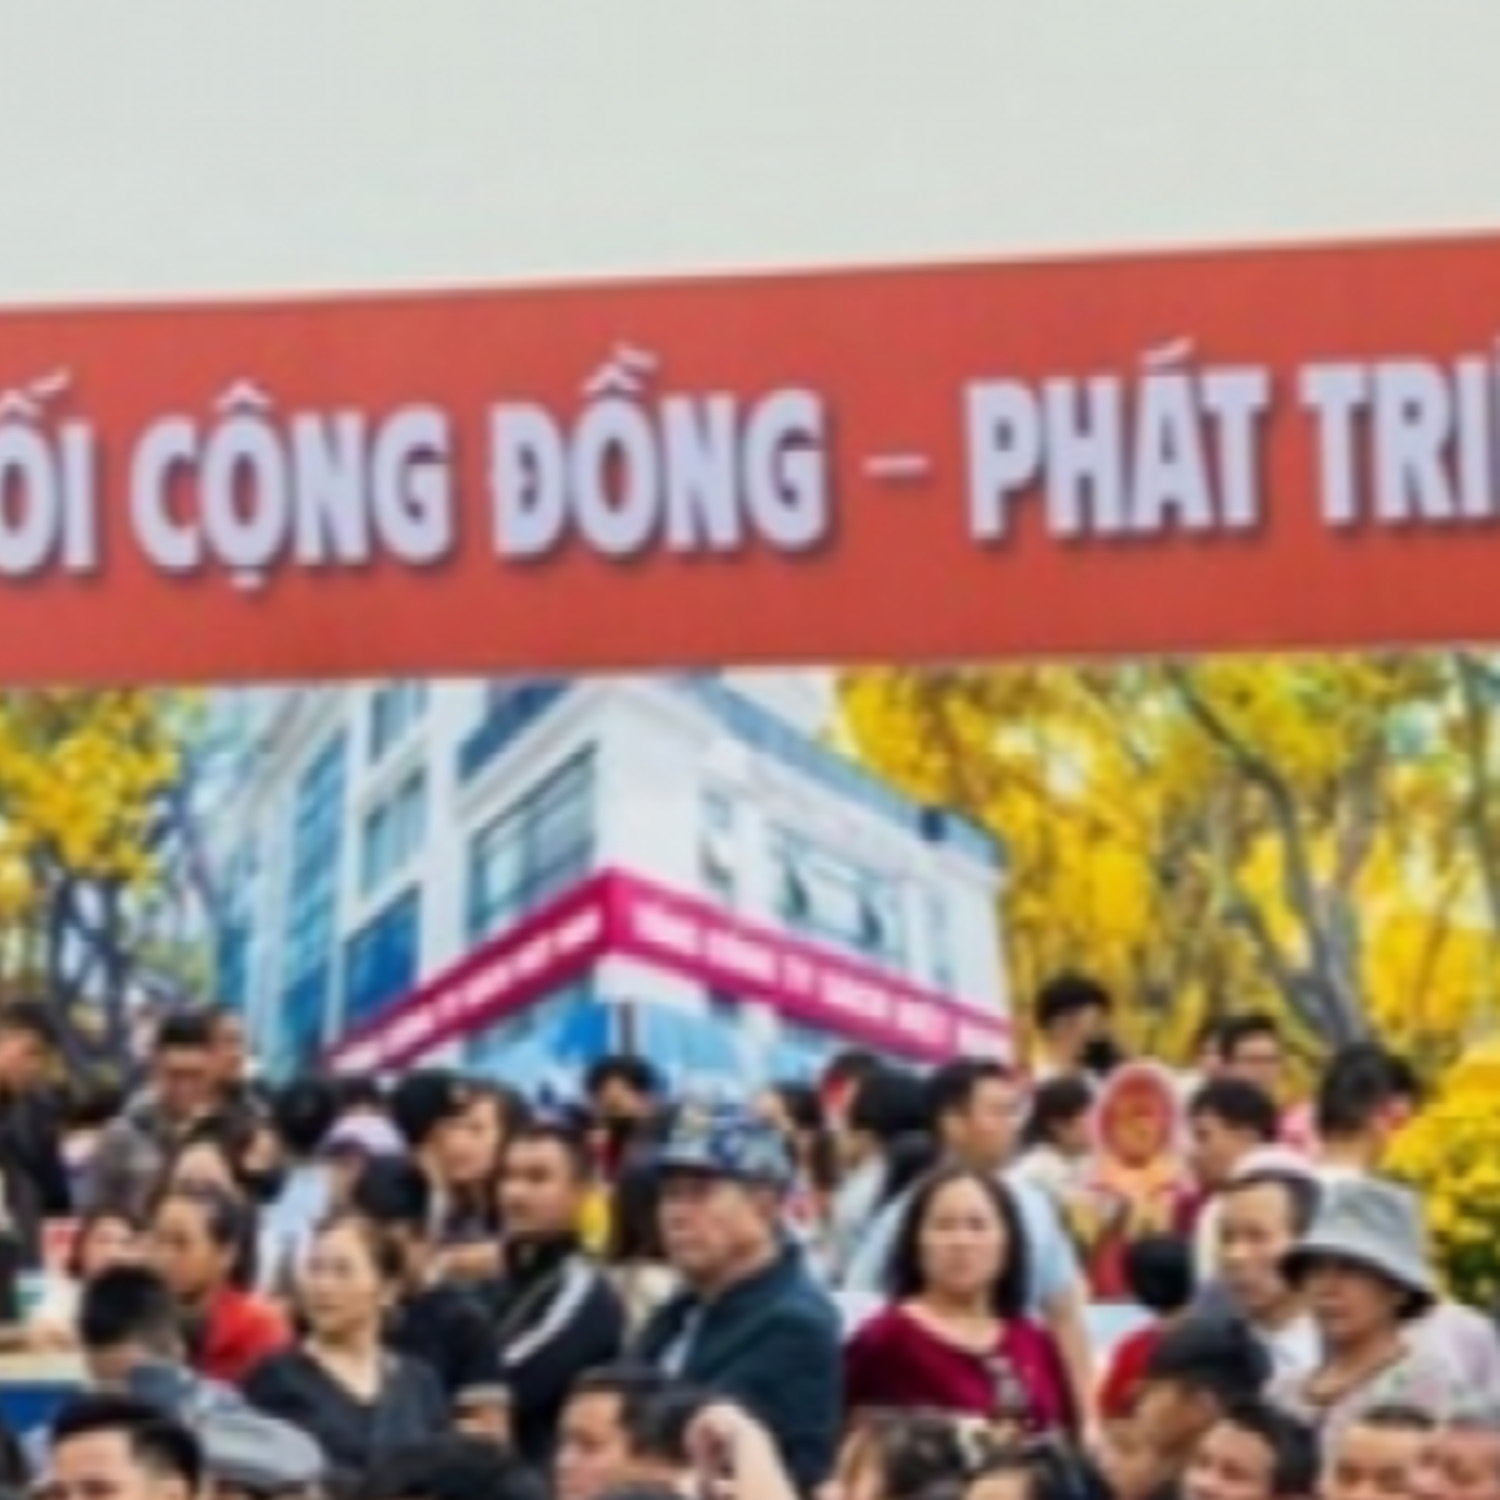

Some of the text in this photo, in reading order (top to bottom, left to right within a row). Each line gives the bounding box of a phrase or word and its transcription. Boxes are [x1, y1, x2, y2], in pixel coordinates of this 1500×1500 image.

[129, 378, 455, 592] CỘNG
[486, 341, 827, 557] ĐỒNG
[964, 336, 1270, 541] PHÁT
[1299, 345, 1500, 528] TRI
